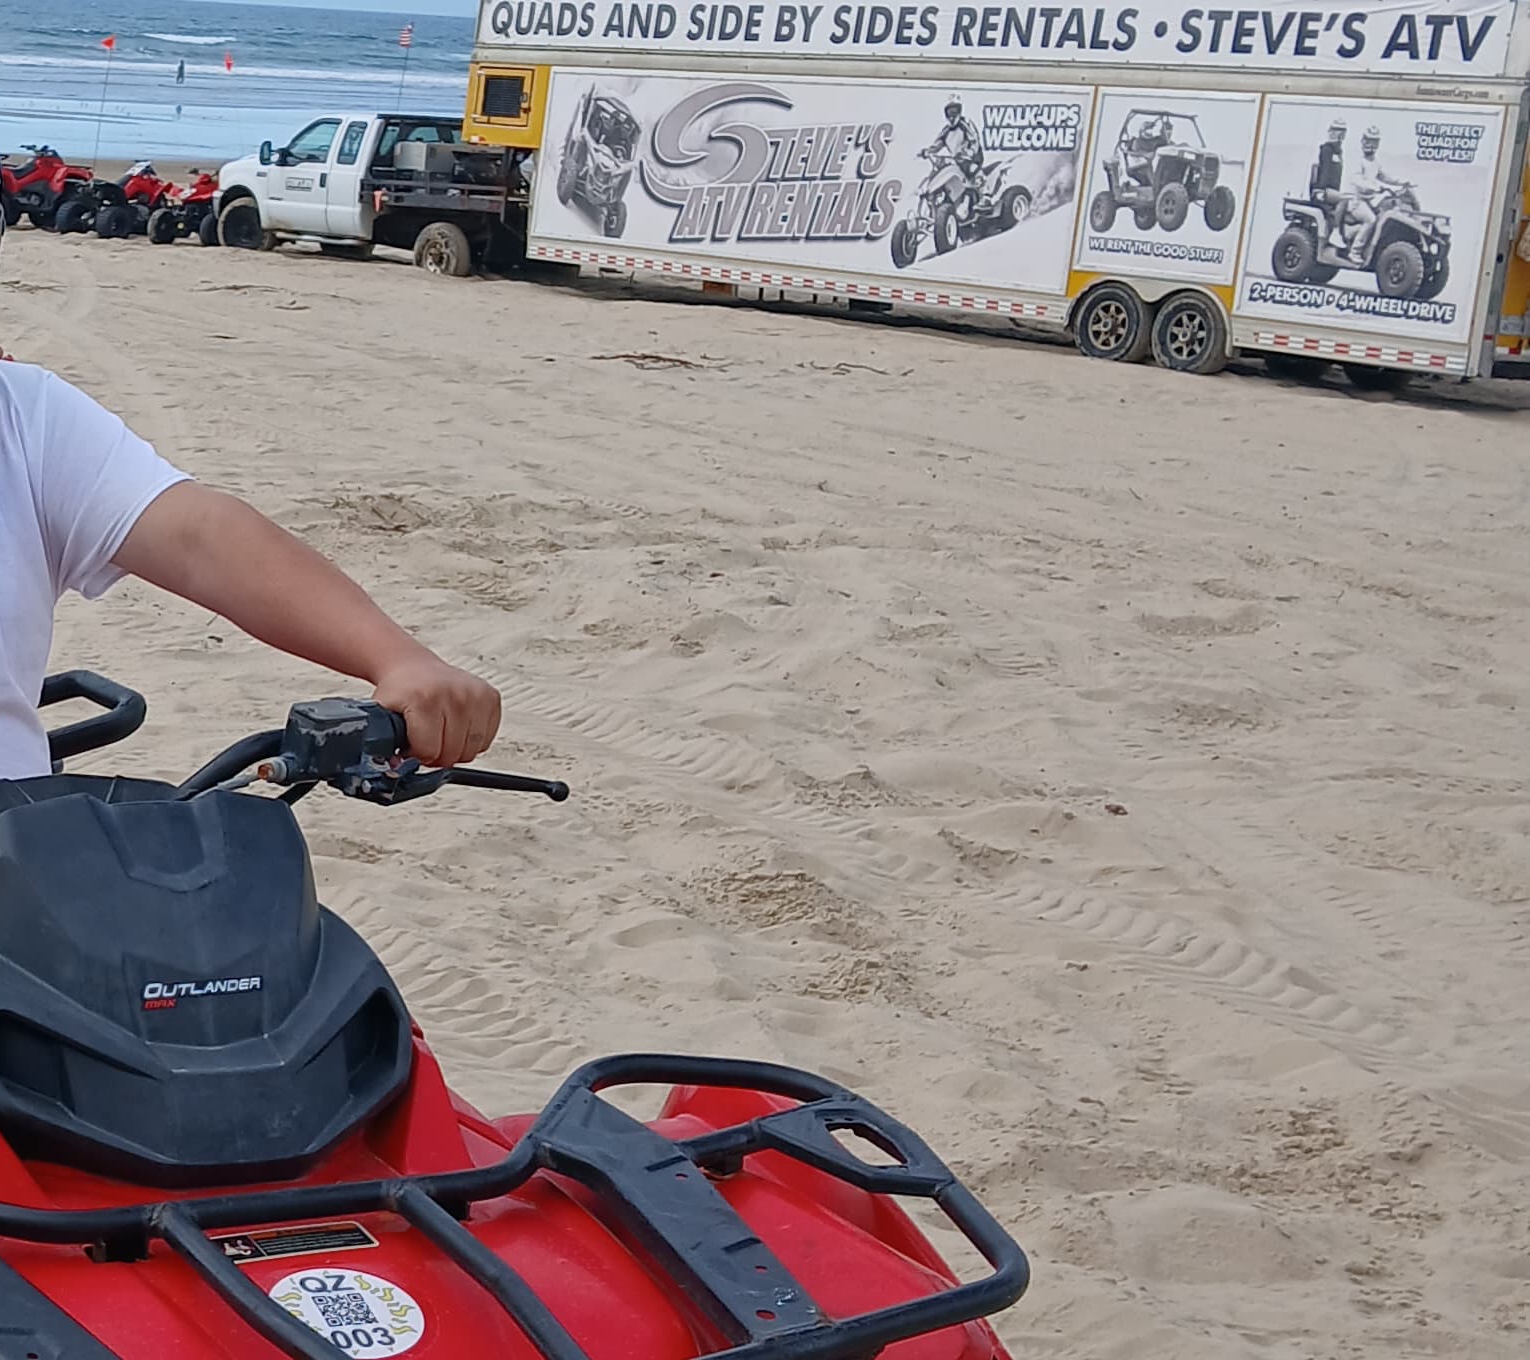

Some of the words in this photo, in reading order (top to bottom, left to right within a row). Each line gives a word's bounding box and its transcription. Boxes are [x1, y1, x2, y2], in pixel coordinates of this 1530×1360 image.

[491, 1, 596, 38] QUADS
[603, 3, 677, 39] AND
[687, 4, 764, 41] SIDE
[773, 5, 823, 43] BY
[830, 5, 939, 46] SIDES
[951, 6, 1138, 52] RENTALS
[1175, 8, 1367, 59] STEVE'S
[1380, 14, 1496, 61] ATV
[983, 104, 1081, 127] WALK-UPS
[983, 127, 1077, 151] WELCOME
[1416, 122, 1437, 136] THE
[1439, 124, 1485, 139] PERFECT
[1418, 136, 1452, 149] QUAD
[1453, 137, 1479, 151] FOR
[669, 183, 752, 243] ATV
[737, 179, 902, 242] RENTALS
[1089, 237, 1105, 251] WE
[1106, 239, 1132, 253] RENT
[1133, 241, 1151, 255] THE
[1153, 242, 1188, 259] GOOD
[1249, 283, 1325, 308] 2-PERSON
[1406, 301, 1456, 324] DRIVE
[144, 977, 260, 998] OUTLANDER
[300, 1275, 355, 1293] QZ
[331, 1327, 395, 1349] 003
